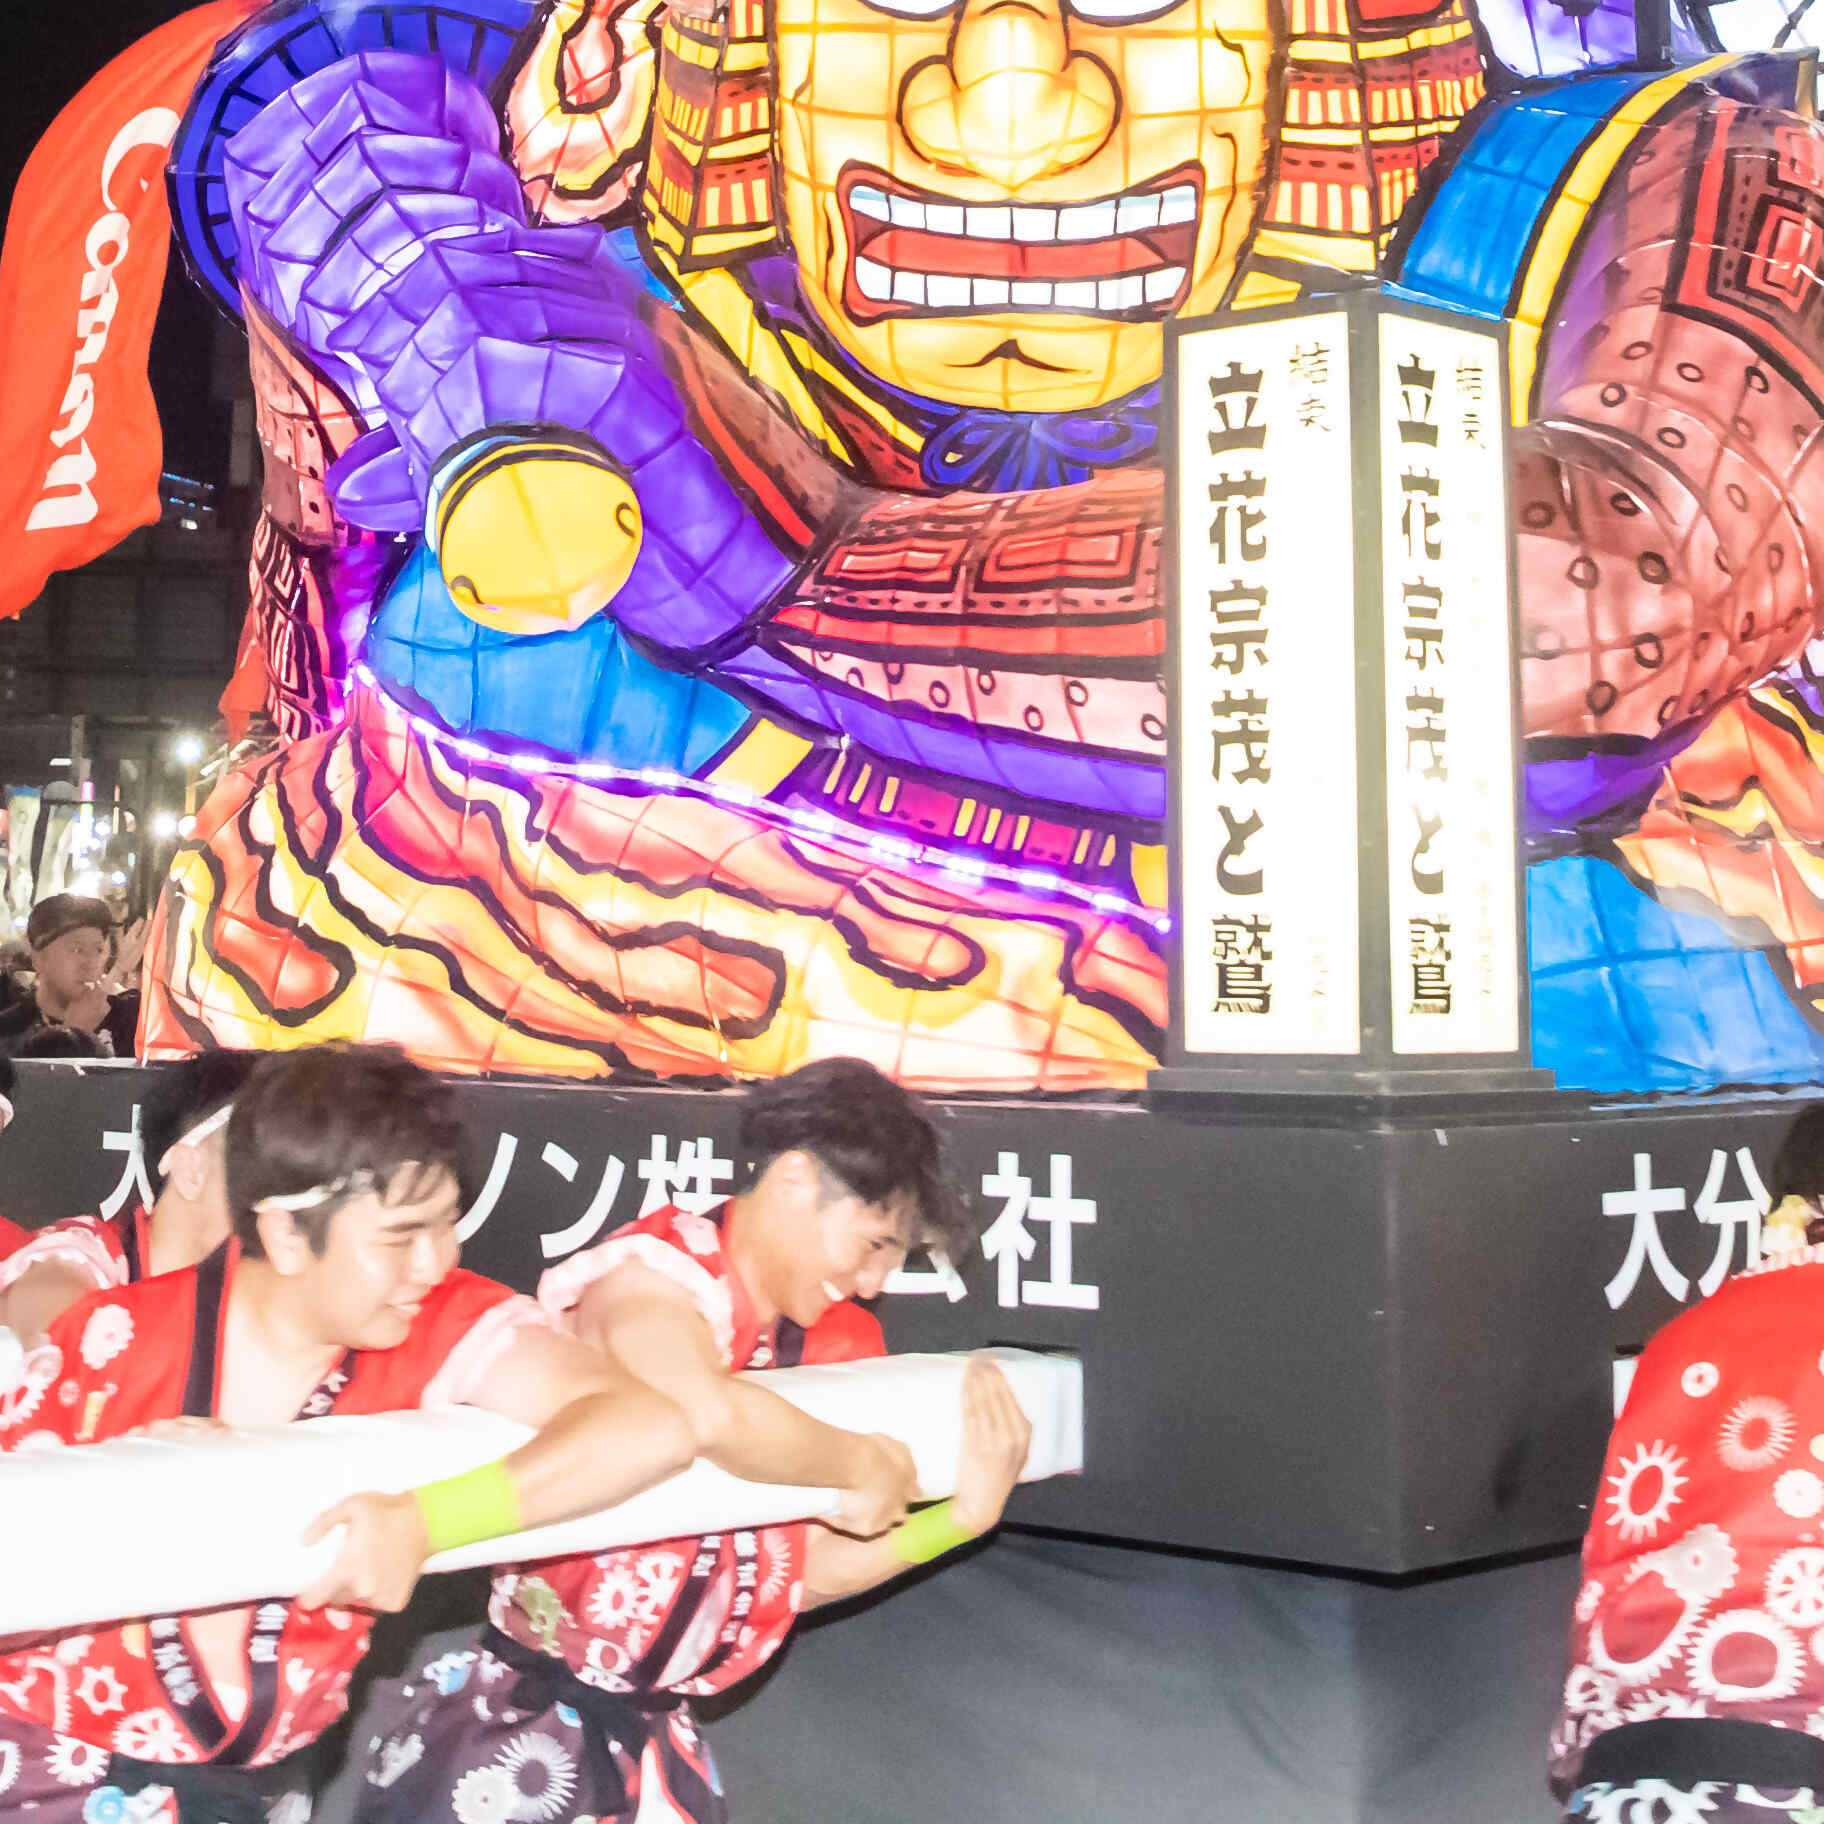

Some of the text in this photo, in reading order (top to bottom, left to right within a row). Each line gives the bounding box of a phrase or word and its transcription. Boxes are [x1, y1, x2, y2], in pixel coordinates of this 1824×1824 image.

[26, 106, 180, 532] Canon
[1207, 361, 1272, 1015] 立花宗茂と鷲
[1396, 353, 1452, 1016] 立花宗茂と鷲
